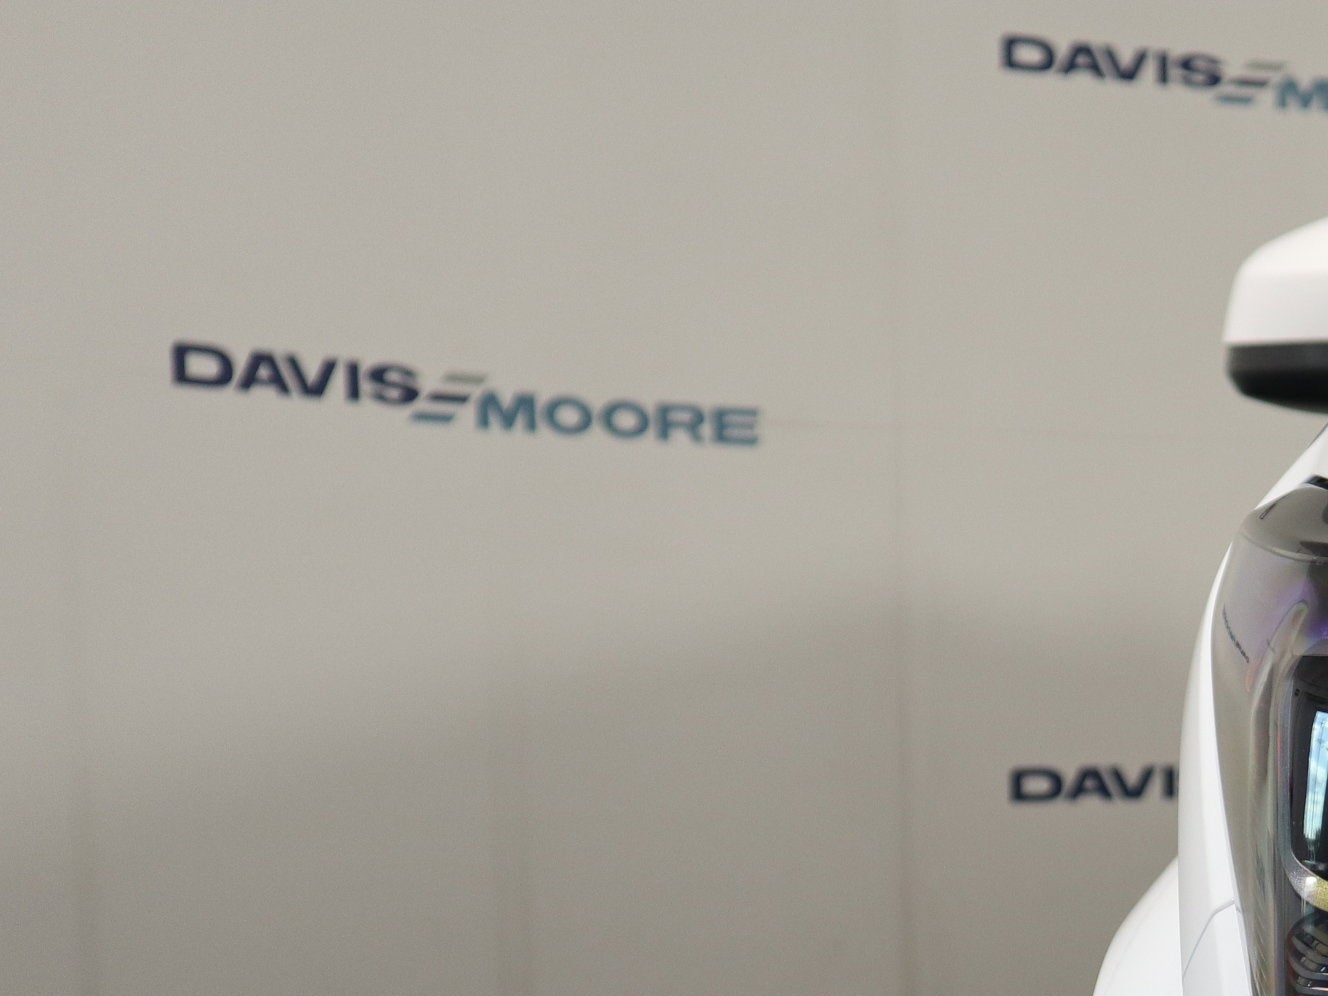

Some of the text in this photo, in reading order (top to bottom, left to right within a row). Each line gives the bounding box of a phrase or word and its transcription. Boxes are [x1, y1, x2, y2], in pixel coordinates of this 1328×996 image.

[1000, 34, 1224, 90] DAVIS
[170, 341, 760, 448] DAVIS MOORE
[1009, 765, 1178, 804] DAVI
